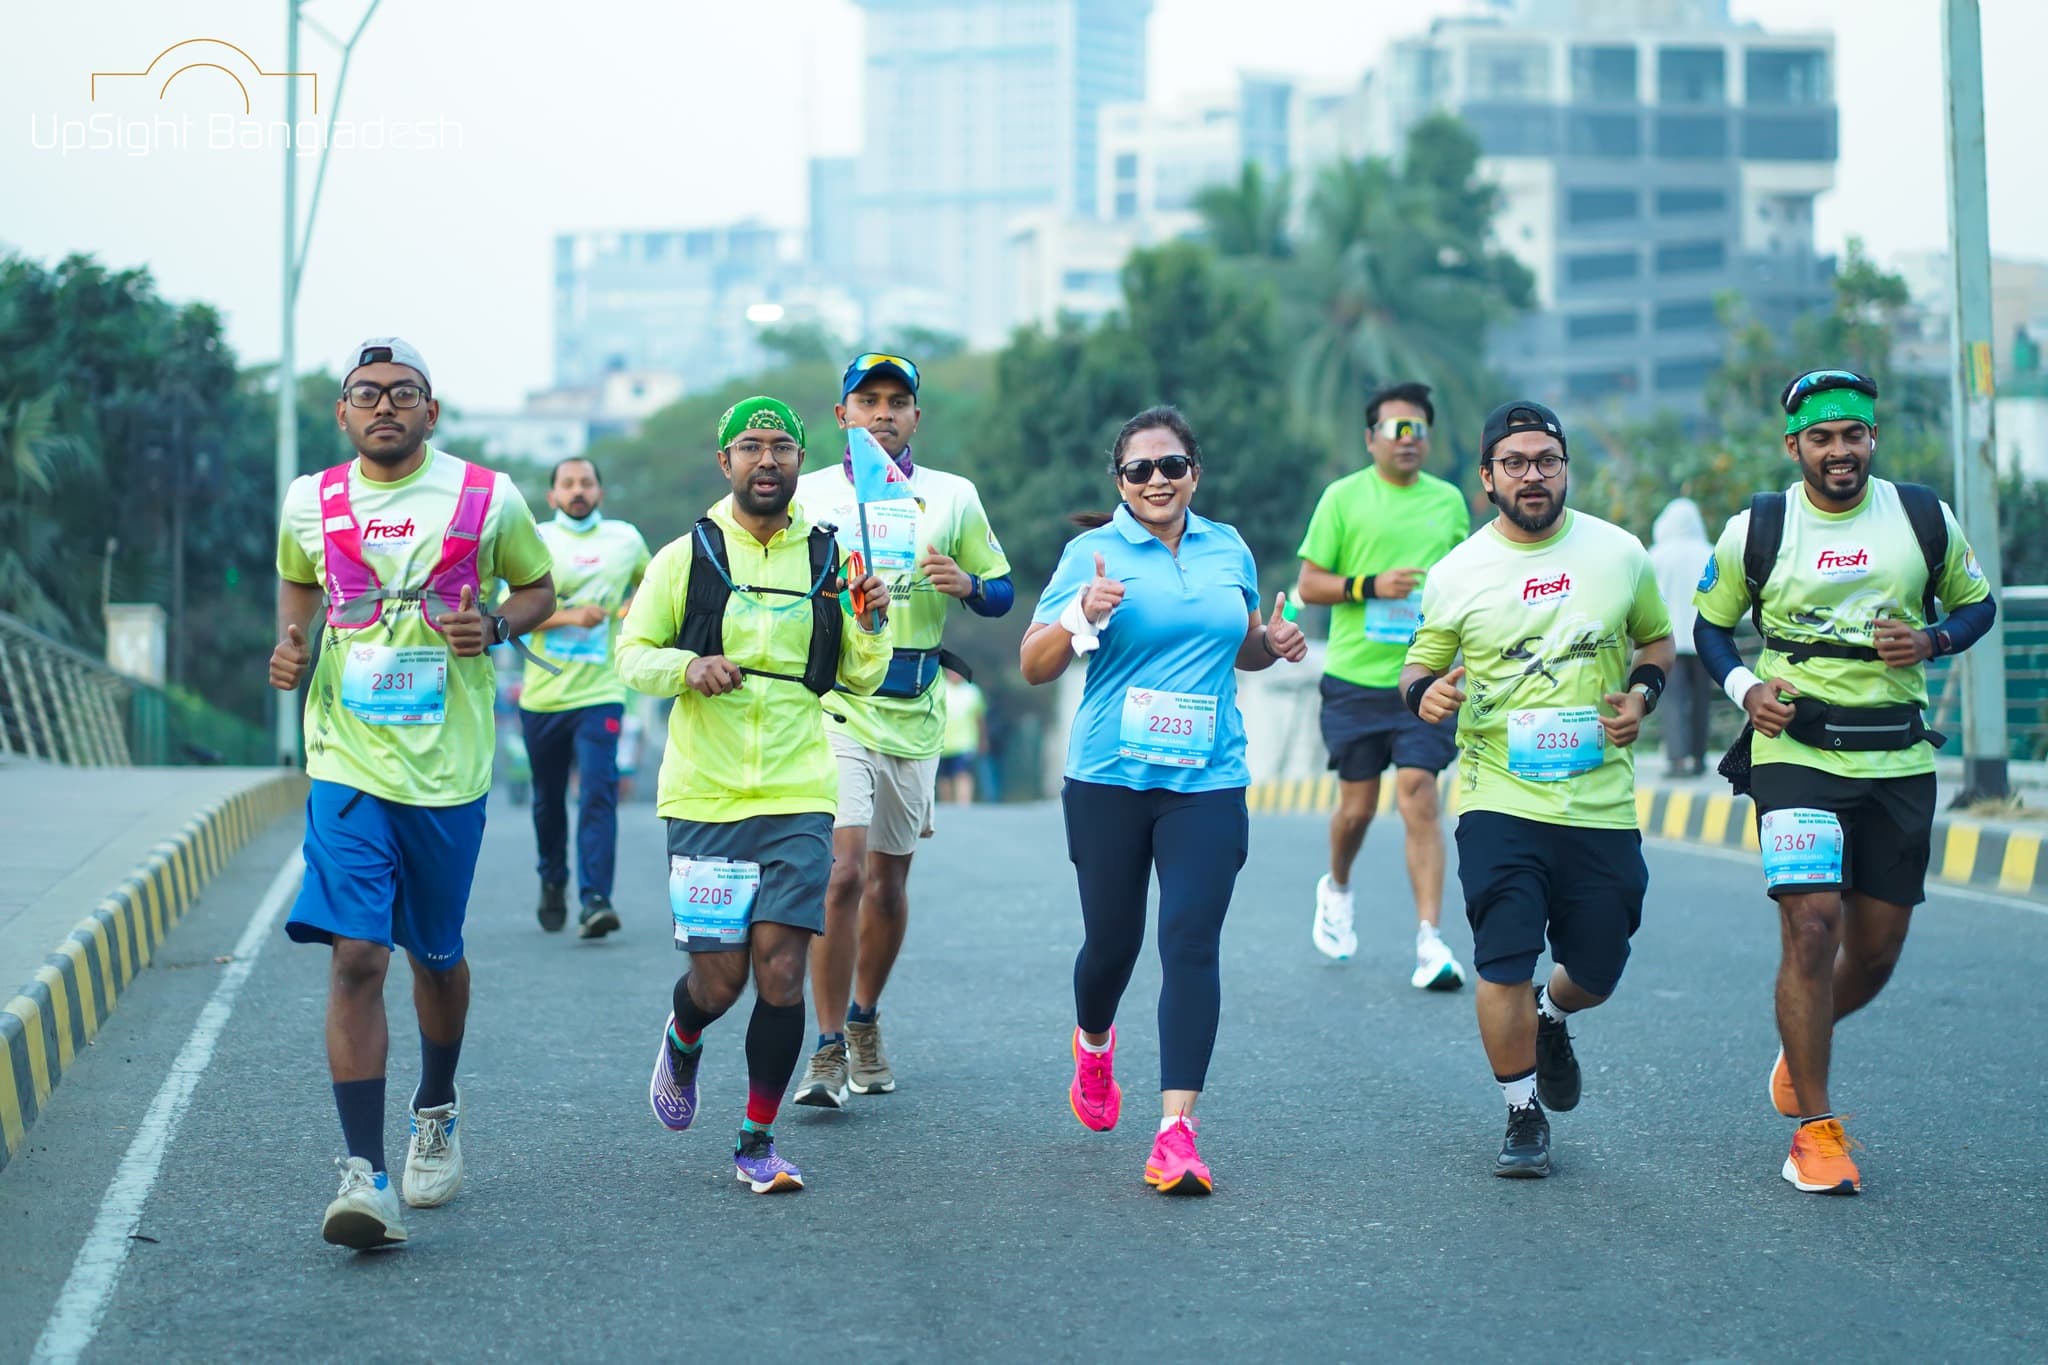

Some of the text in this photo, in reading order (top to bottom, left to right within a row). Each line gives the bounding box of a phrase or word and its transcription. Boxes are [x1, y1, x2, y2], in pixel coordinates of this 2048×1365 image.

[363, 518, 415, 540] Fresh
[1817, 548, 1868, 570] Fresh
[1523, 572, 1570, 600] Fresh
[371, 672, 414, 691] 2331
[1149, 715, 1193, 736] 2233
[1536, 732, 1579, 750] 2336
[1774, 833, 1816, 852] 2367
[688, 886, 733, 905] 2205
